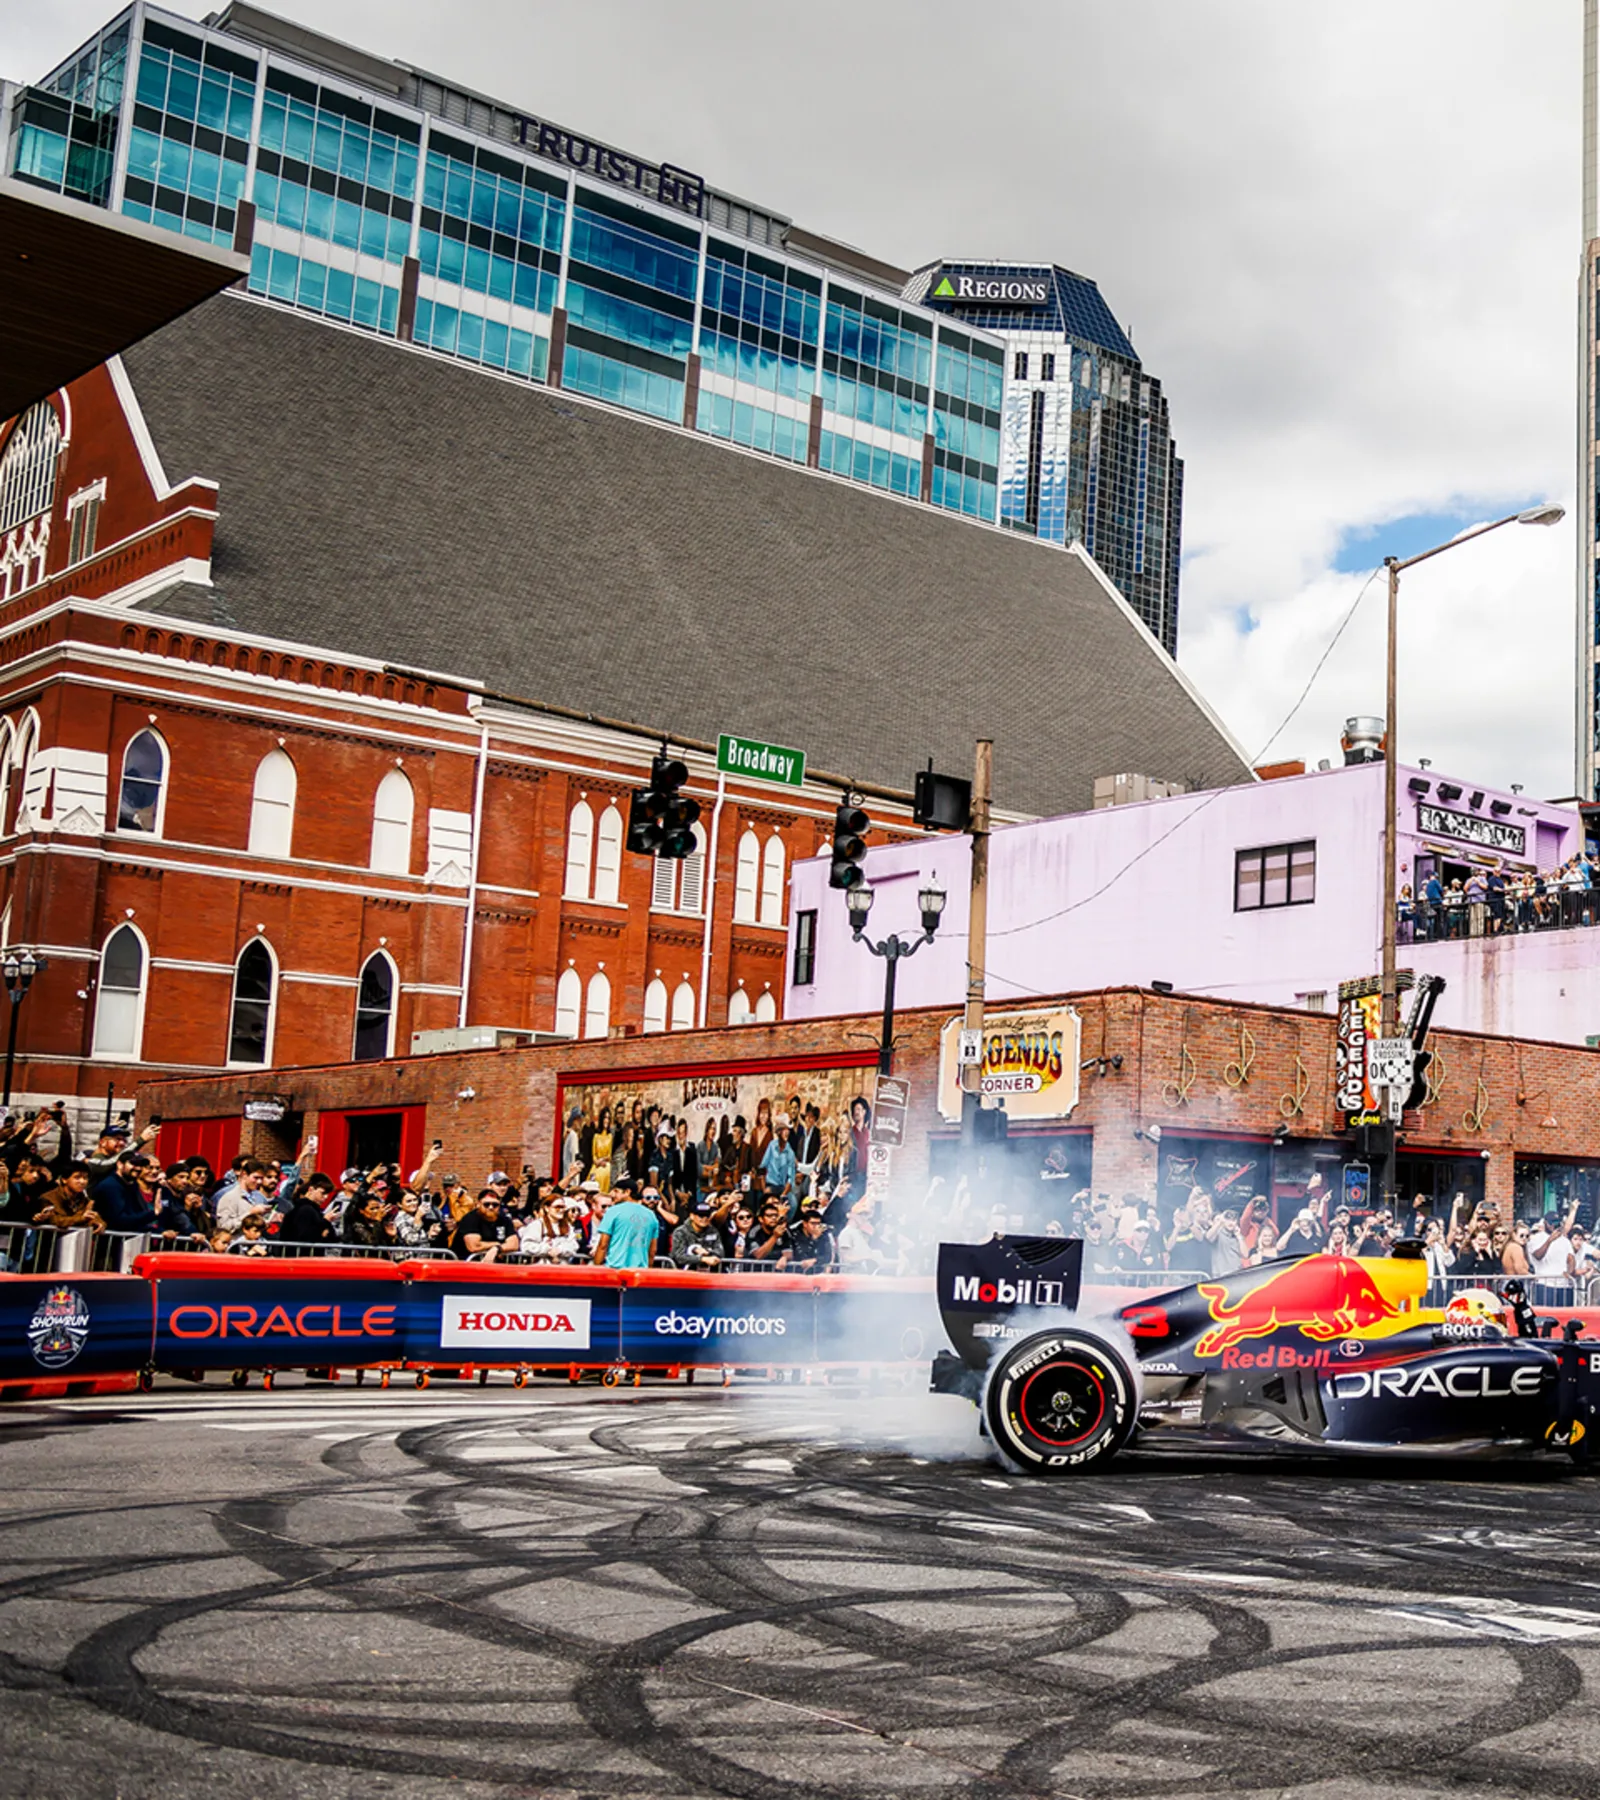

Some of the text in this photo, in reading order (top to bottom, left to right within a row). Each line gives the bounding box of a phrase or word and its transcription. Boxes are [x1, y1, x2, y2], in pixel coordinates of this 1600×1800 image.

[514, 112, 661, 189] TRUIST
[957, 276, 1046, 300] REGIONS
[728, 739, 794, 782] Broadway
[981, 1031, 1063, 1080] GENDS
[1348, 1000, 1364, 1111] LEGENDS
[1373, 1050, 1407, 1058] CROSSING
[1370, 1062, 1388, 1079] OK
[683, 1076, 739, 1107] LEGENDS
[953, 1276, 1032, 1304] Mobil
[29, 1314, 90, 1329] SHOWRUN
[169, 1305, 397, 1338] ORACLE
[458, 1312, 575, 1333] HONDA
[1122, 1306, 1169, 1337] 3
[1442, 1323, 1485, 1337] ROKT
[1008, 1340, 1062, 1380] PIRELLI
[1136, 1362, 1178, 1372] ONDA
[1221, 1345, 1330, 1370] Red Bull
[1326, 1366, 1543, 1399] ORACLE
[1048, 1428, 1115, 1466] ZERO
